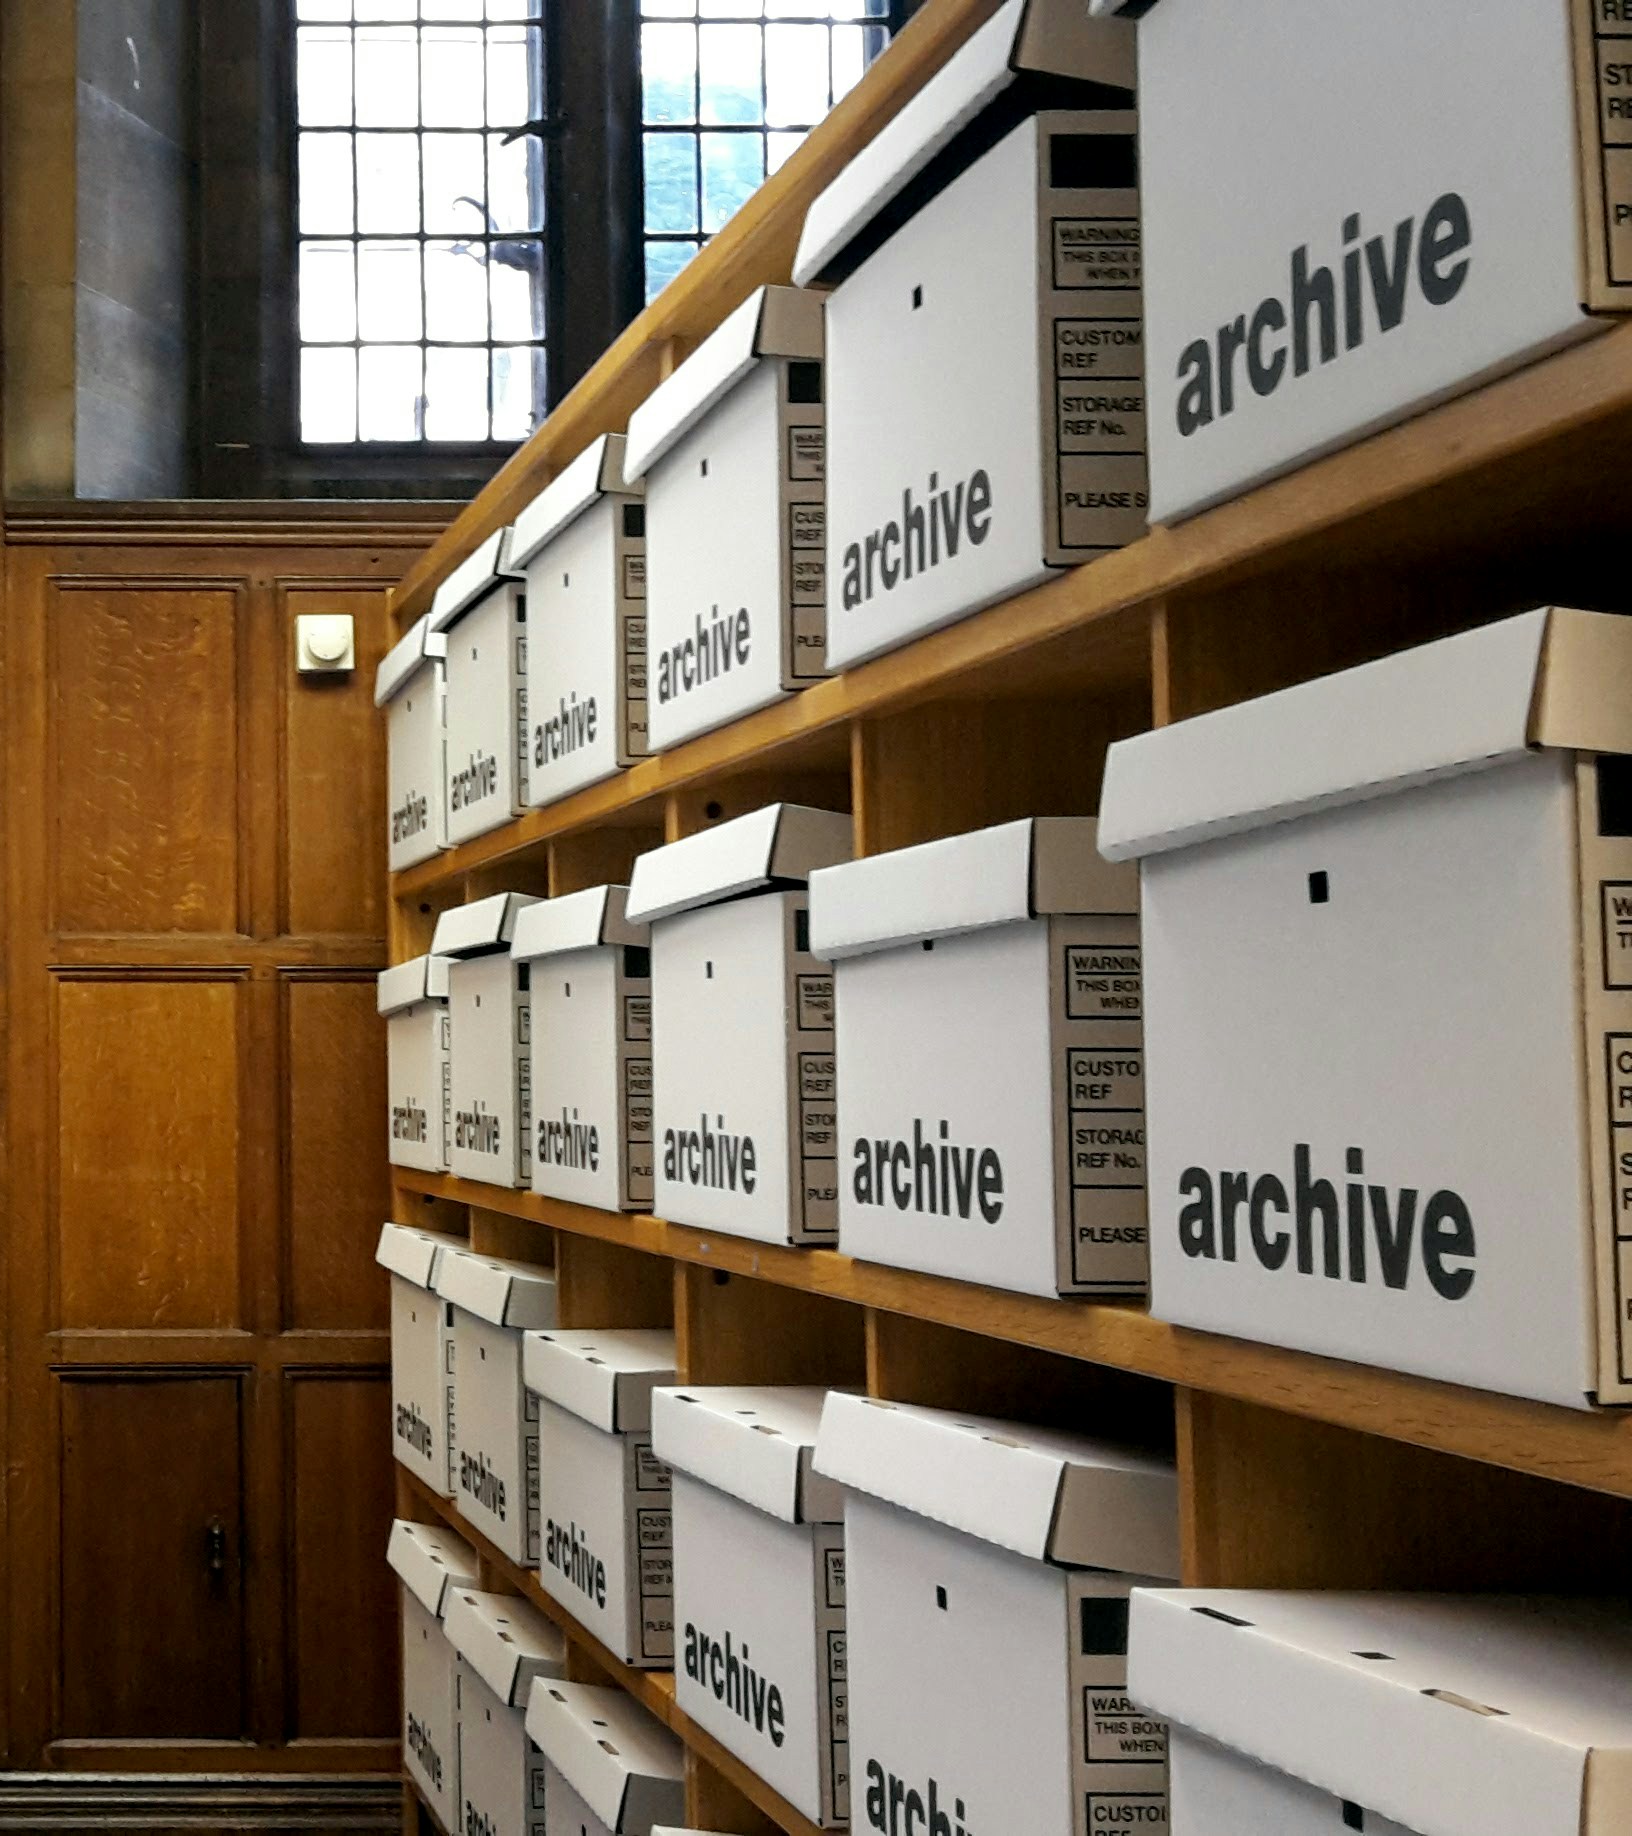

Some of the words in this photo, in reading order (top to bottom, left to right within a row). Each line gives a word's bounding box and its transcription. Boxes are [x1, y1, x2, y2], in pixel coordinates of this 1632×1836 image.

[1176, 192, 1472, 437] archive
[1062, 352, 1098, 368] REF
[1063, 419, 1098, 435] REF
[1065, 492, 1131, 508] PLEASE
[842, 469, 992, 611] archive
[658, 605, 752, 705] archive
[535, 692, 597, 769] archive
[450, 750, 497, 813] archive
[392, 791, 428, 845] archive
[393, 1097, 427, 1143] archive
[1075, 1083, 1113, 1099] REF
[455, 1101, 500, 1155] archive
[538, 1107, 599, 1172] archive
[664, 1114, 757, 1194] archive
[854, 1119, 1004, 1224] archive
[1076, 1152, 1111, 1168] REF
[1078, 1227, 1147, 1244] PLEASE
[1179, 1144, 1476, 1300] archive
[396, 1401, 432, 1461] archive
[460, 1450, 506, 1521] archive
[546, 1518, 607, 1610] archive
[684, 1622, 786, 1749] archive
[1094, 1721, 1127, 1735] THIS
